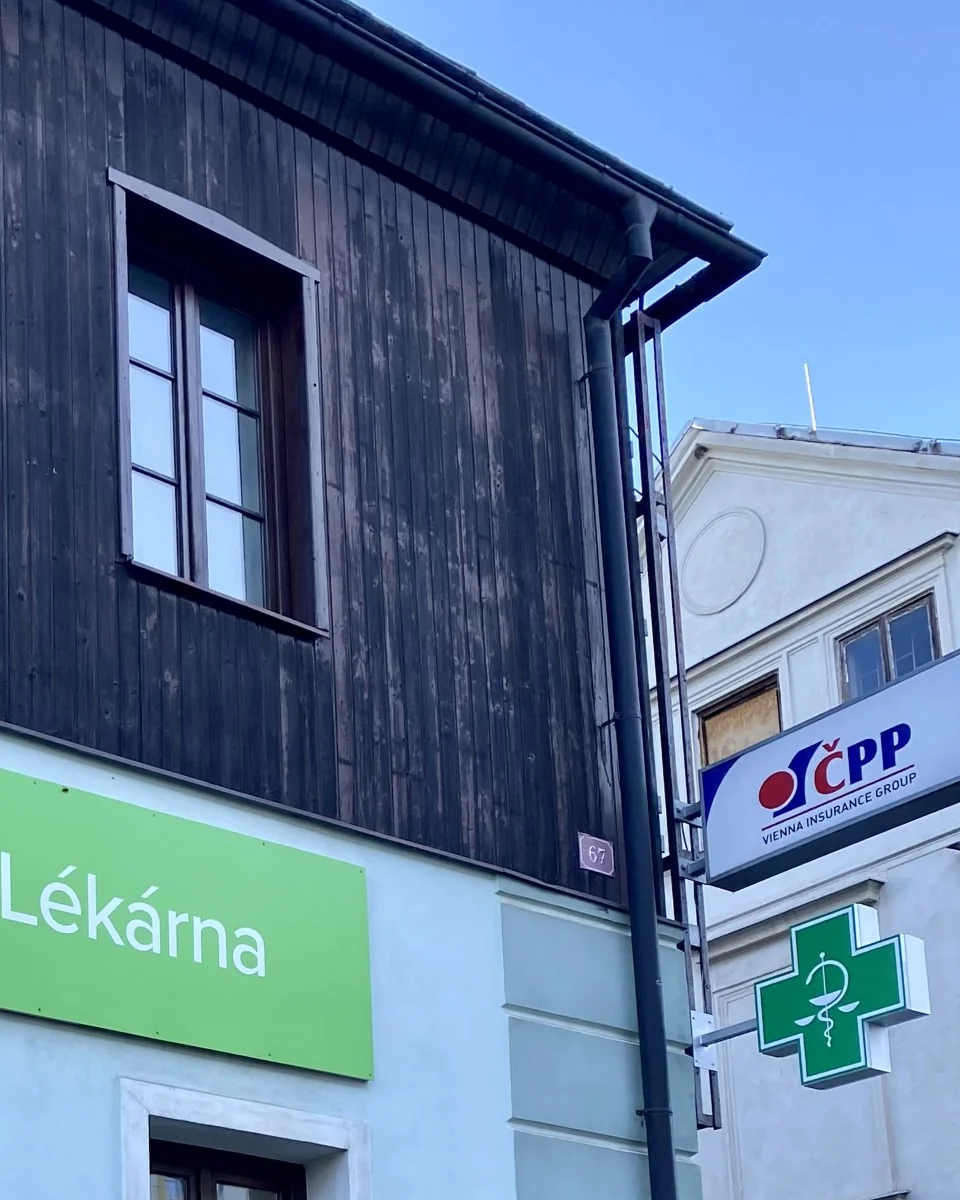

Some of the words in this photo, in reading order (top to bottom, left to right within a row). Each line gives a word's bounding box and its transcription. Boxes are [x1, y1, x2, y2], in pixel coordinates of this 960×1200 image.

[814, 722, 912, 795] ČPP
[762, 820, 804, 845] VIENNA
[806, 791, 872, 828] INSURANCE
[875, 772, 917, 798] GROUP
[589, 845, 606, 864] 67
[0, 851, 267, 979] Lékárna
